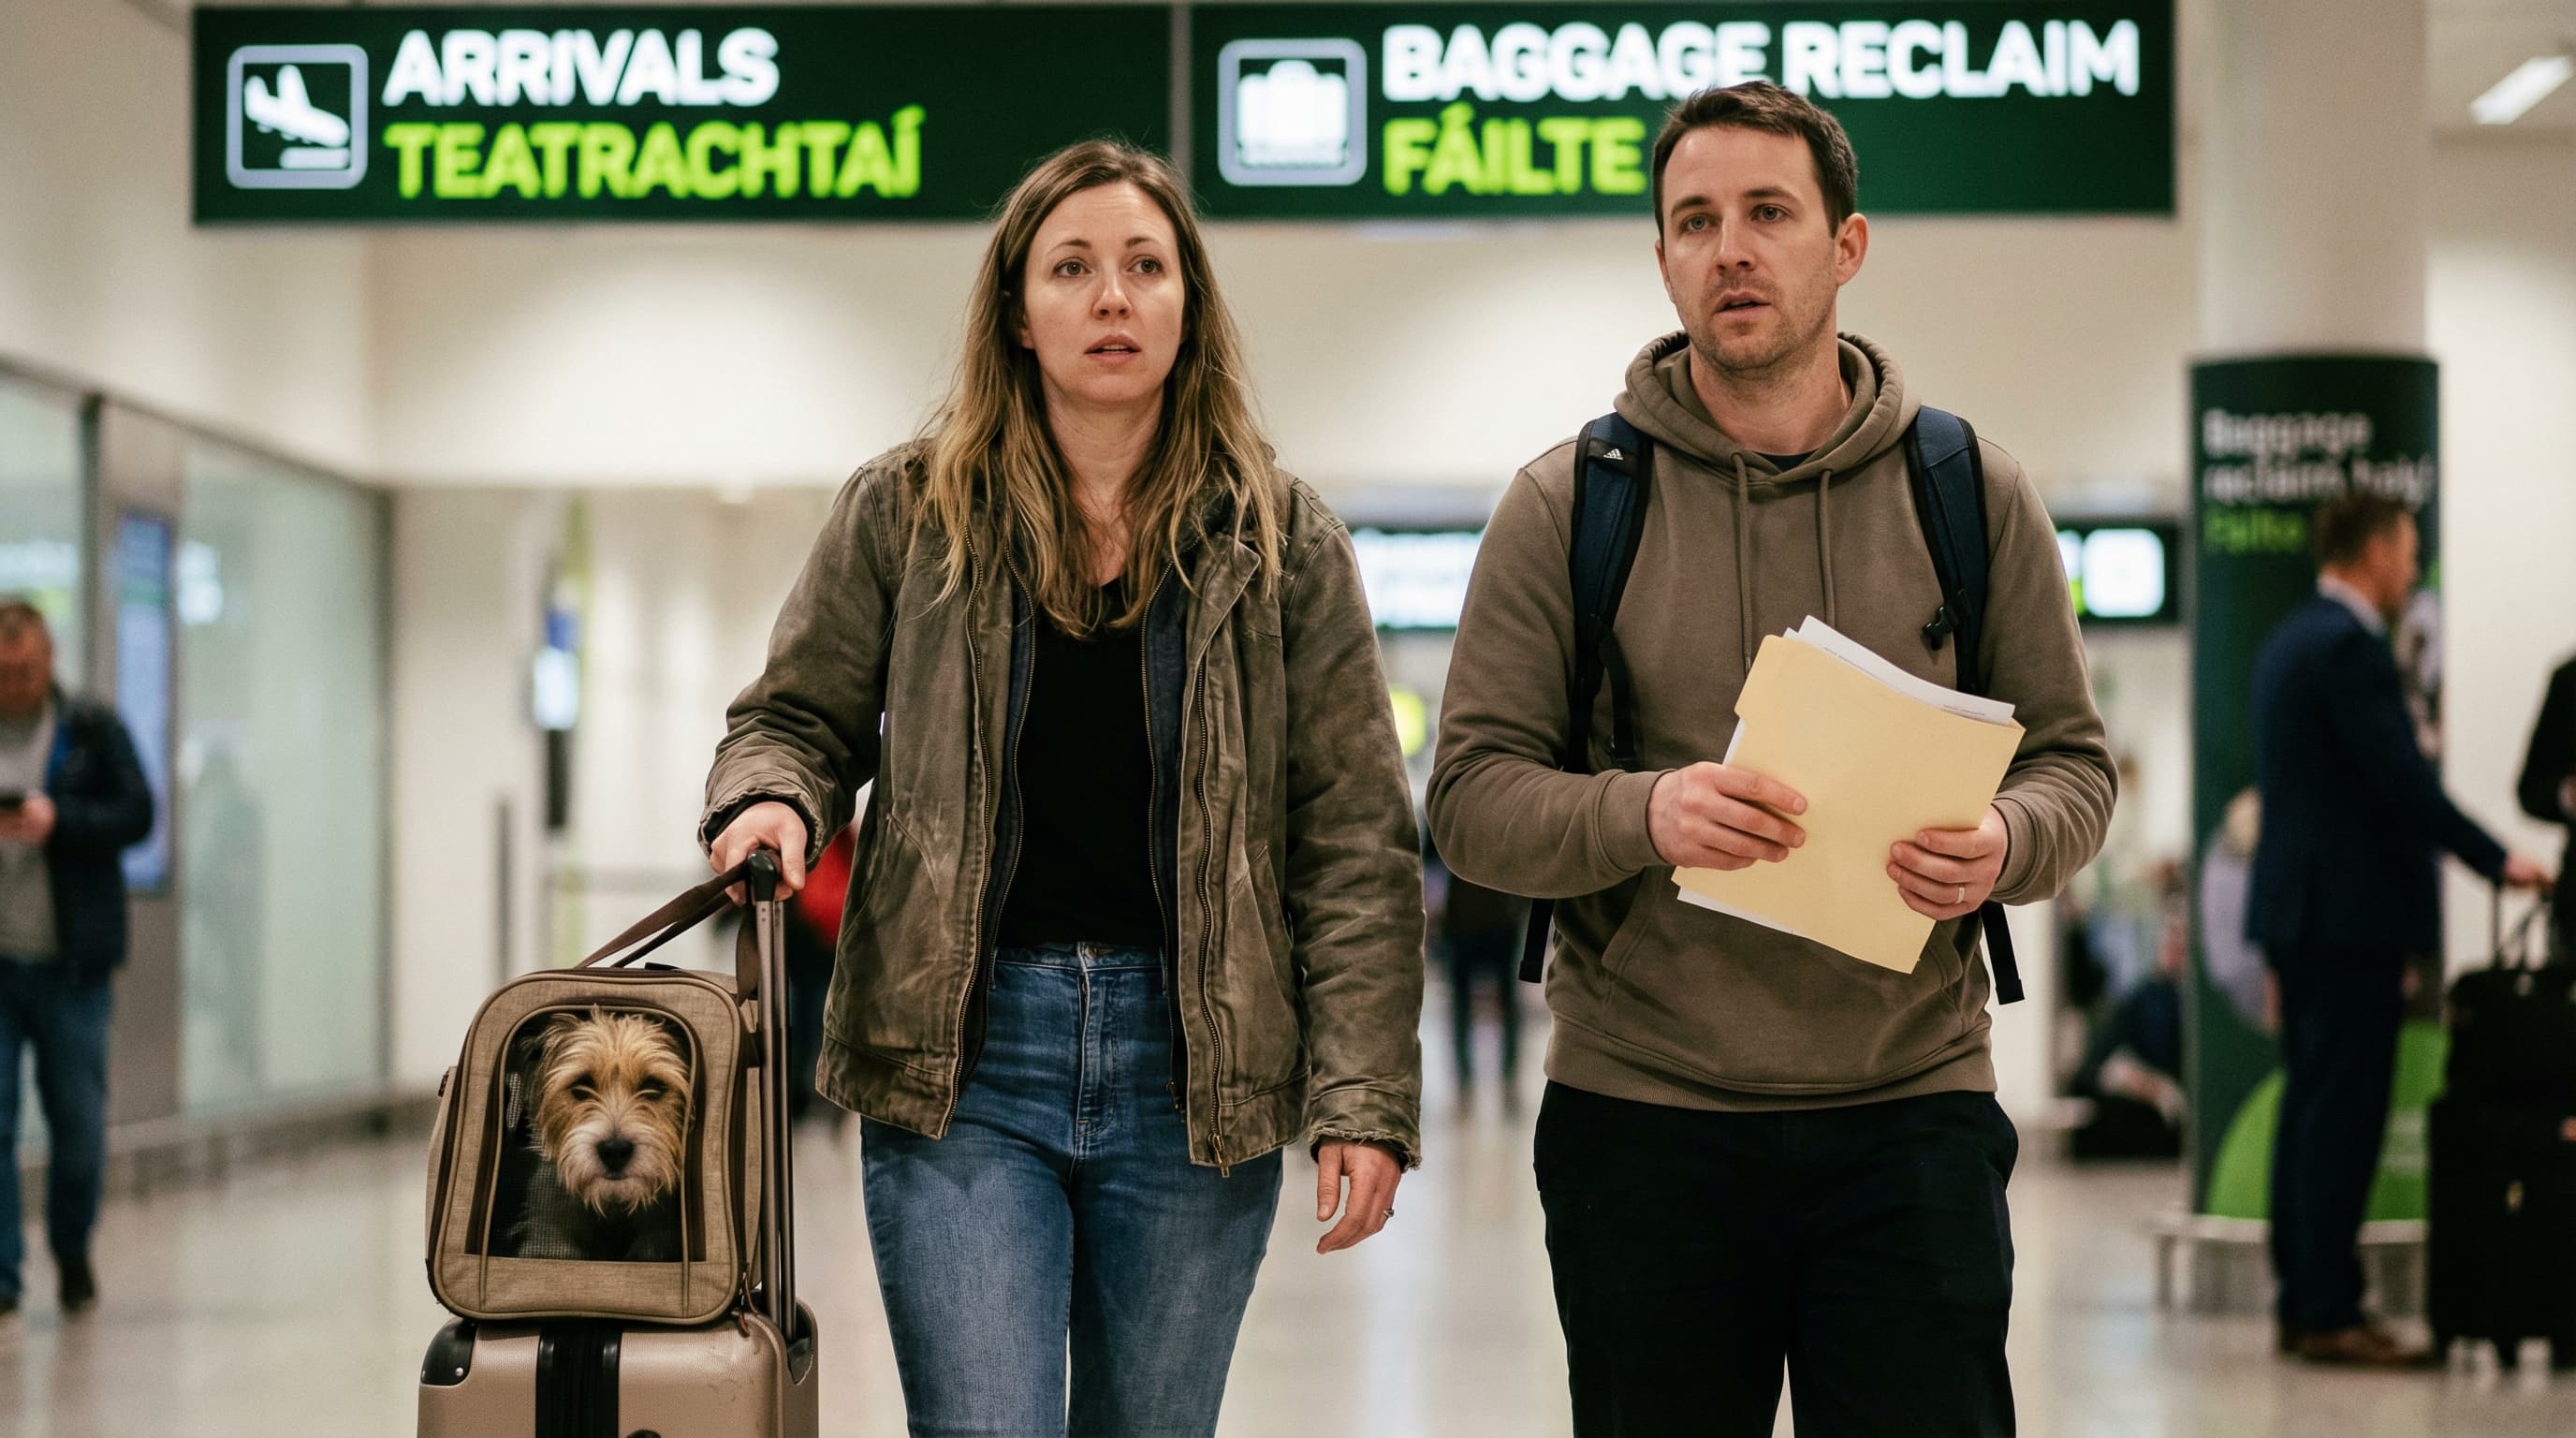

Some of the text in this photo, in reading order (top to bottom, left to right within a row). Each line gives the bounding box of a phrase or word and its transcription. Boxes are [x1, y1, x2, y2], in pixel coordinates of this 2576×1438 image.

[382, 27, 780, 107] ARRIVALS
[1382, 19, 2140, 102] BAGGAGE RECLAIM
[382, 102, 925, 199] TEATRACHTAÍ
[1382, 100, 1649, 197] FÁILTE
